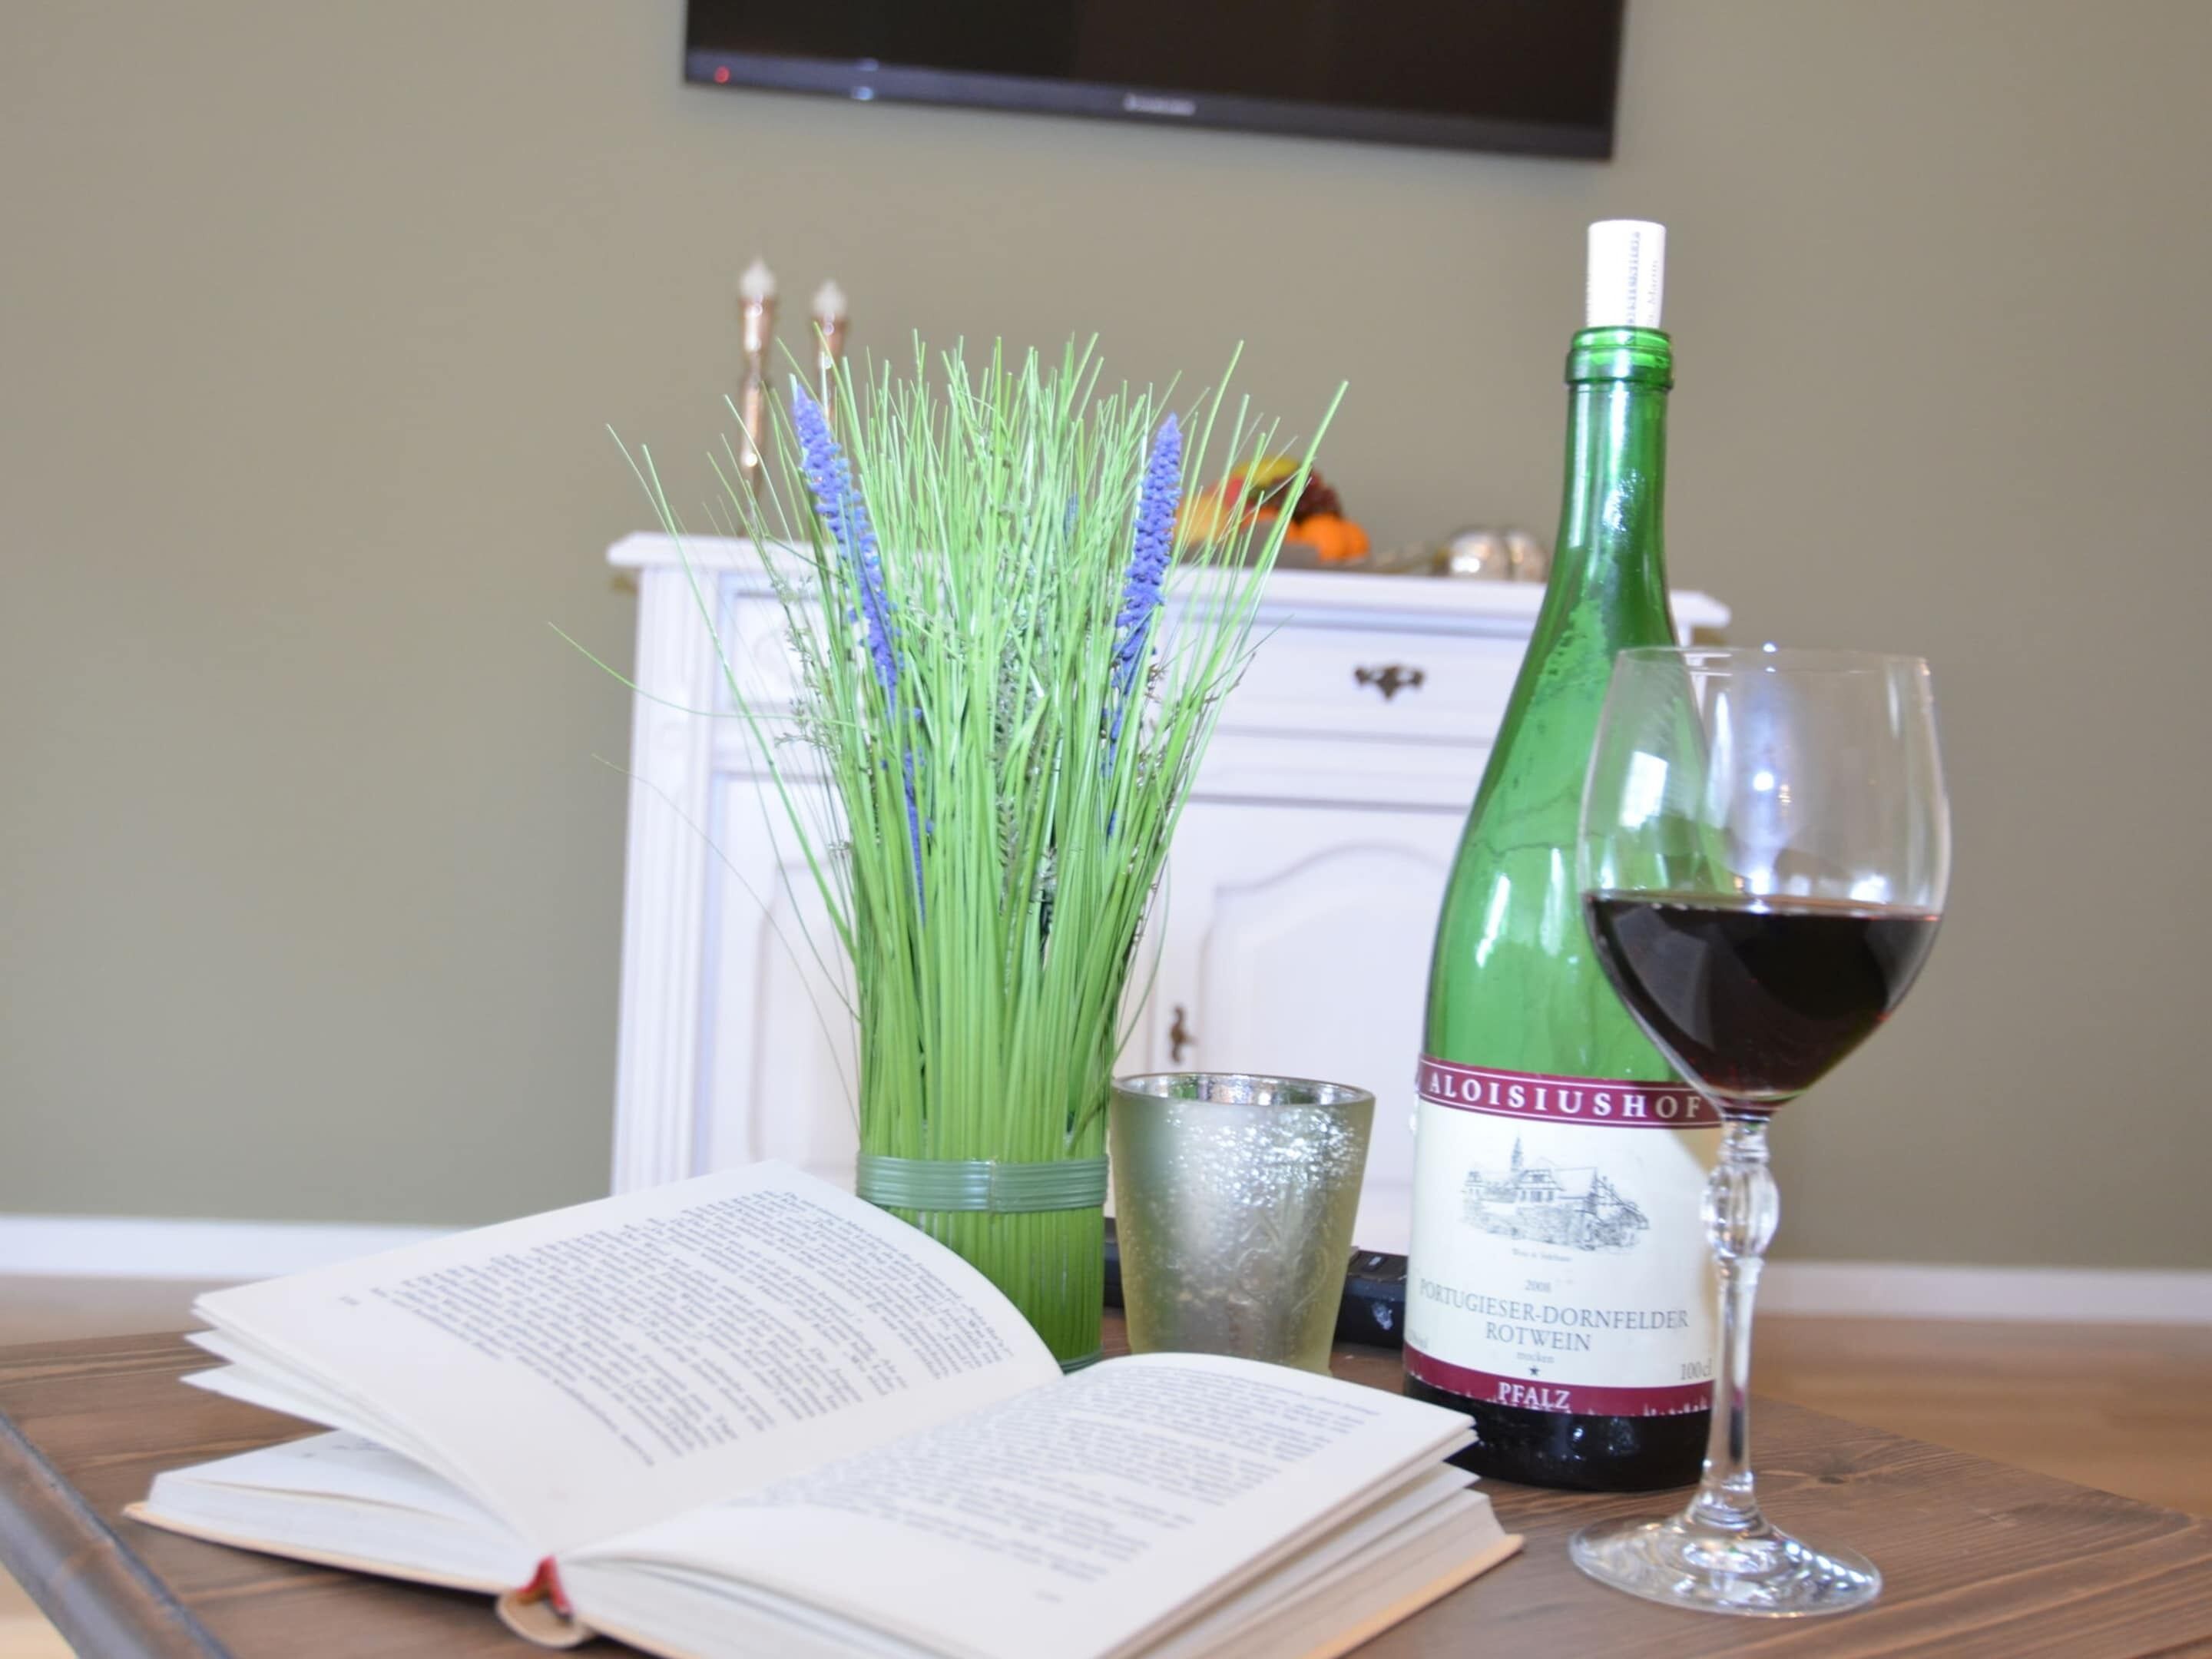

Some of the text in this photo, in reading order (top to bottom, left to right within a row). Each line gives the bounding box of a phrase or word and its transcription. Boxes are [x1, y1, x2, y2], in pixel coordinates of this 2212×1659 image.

[1429, 1071, 1702, 1118] ALOISIUSHOF
[1419, 1278, 1690, 1330] PORTUGIESER-DORNFELDER
[1486, 1321, 1591, 1350] ROTWEIN
[1498, 1381, 1571, 1409] PFALZ
